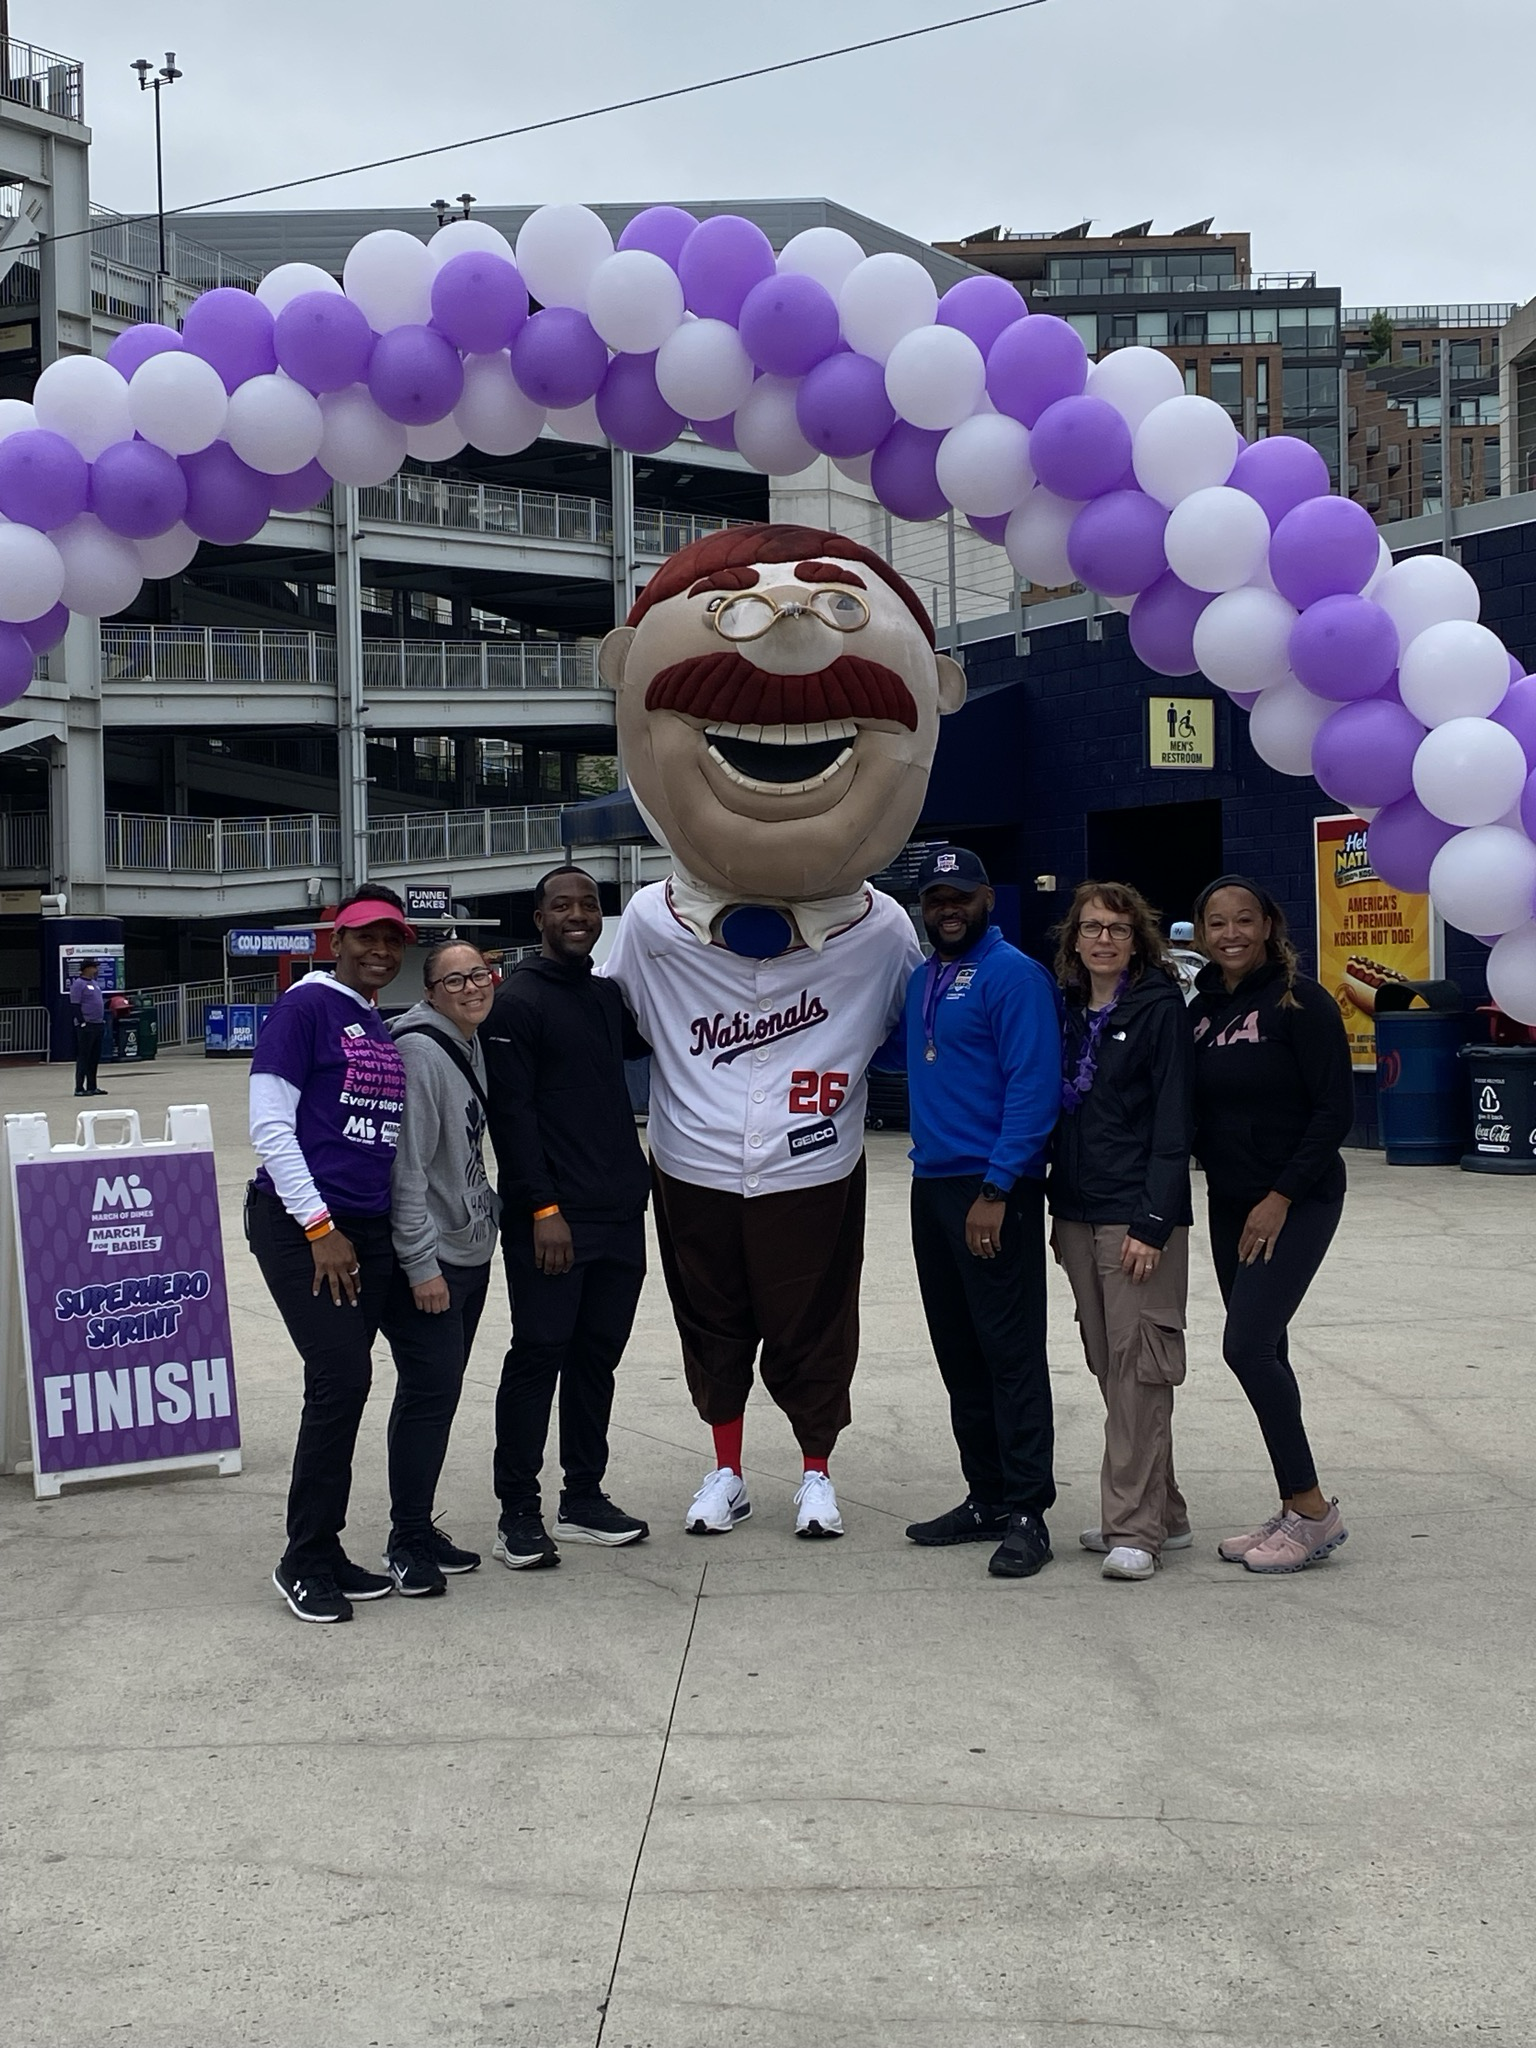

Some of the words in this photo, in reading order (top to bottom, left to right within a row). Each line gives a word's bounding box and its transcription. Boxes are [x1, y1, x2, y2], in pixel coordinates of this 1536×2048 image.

[1170, 741, 1194, 751] MEN'S
[1162, 753, 1203, 763] RESTROOM
[409, 891, 448, 900] FUNNEL
[1347, 895, 1397, 912] AMERICA'S
[412, 900, 446, 908] CAKES
[1358, 912, 1403, 928] PREMIUM
[238, 936, 260, 950] COLD
[261, 936, 310, 950] BEVERAGES
[1334, 931, 1369, 947] KOSHER
[1371, 930, 1389, 945] HOT
[1392, 928, 1414, 944] DOG!
[233, 1027, 251, 1035] BUD
[689, 988, 829, 1062] Nationals
[344, 1048, 377, 1059] Every
[346, 1067, 384, 1085] Every
[384, 1074, 401, 1086] step
[343, 1079, 383, 1097] Every
[382, 1086, 400, 1099] step
[789, 1071, 849, 1116] 26
[339, 1091, 378, 1110] Every
[378, 1099, 398, 1113] step
[792, 1127, 834, 1149] GEICO
[91, 1212, 119, 1222] MARCH
[119, 1211, 129, 1220] OF
[130, 1210, 154, 1219] DIMES
[92, 1227, 141, 1241] MARCH
[111, 1239, 157, 1253] BABIES
[55, 1270, 211, 1321] SUPERHERO
[86, 1304, 183, 1350] SPRINT
[43, 1357, 231, 1438] FINISH
